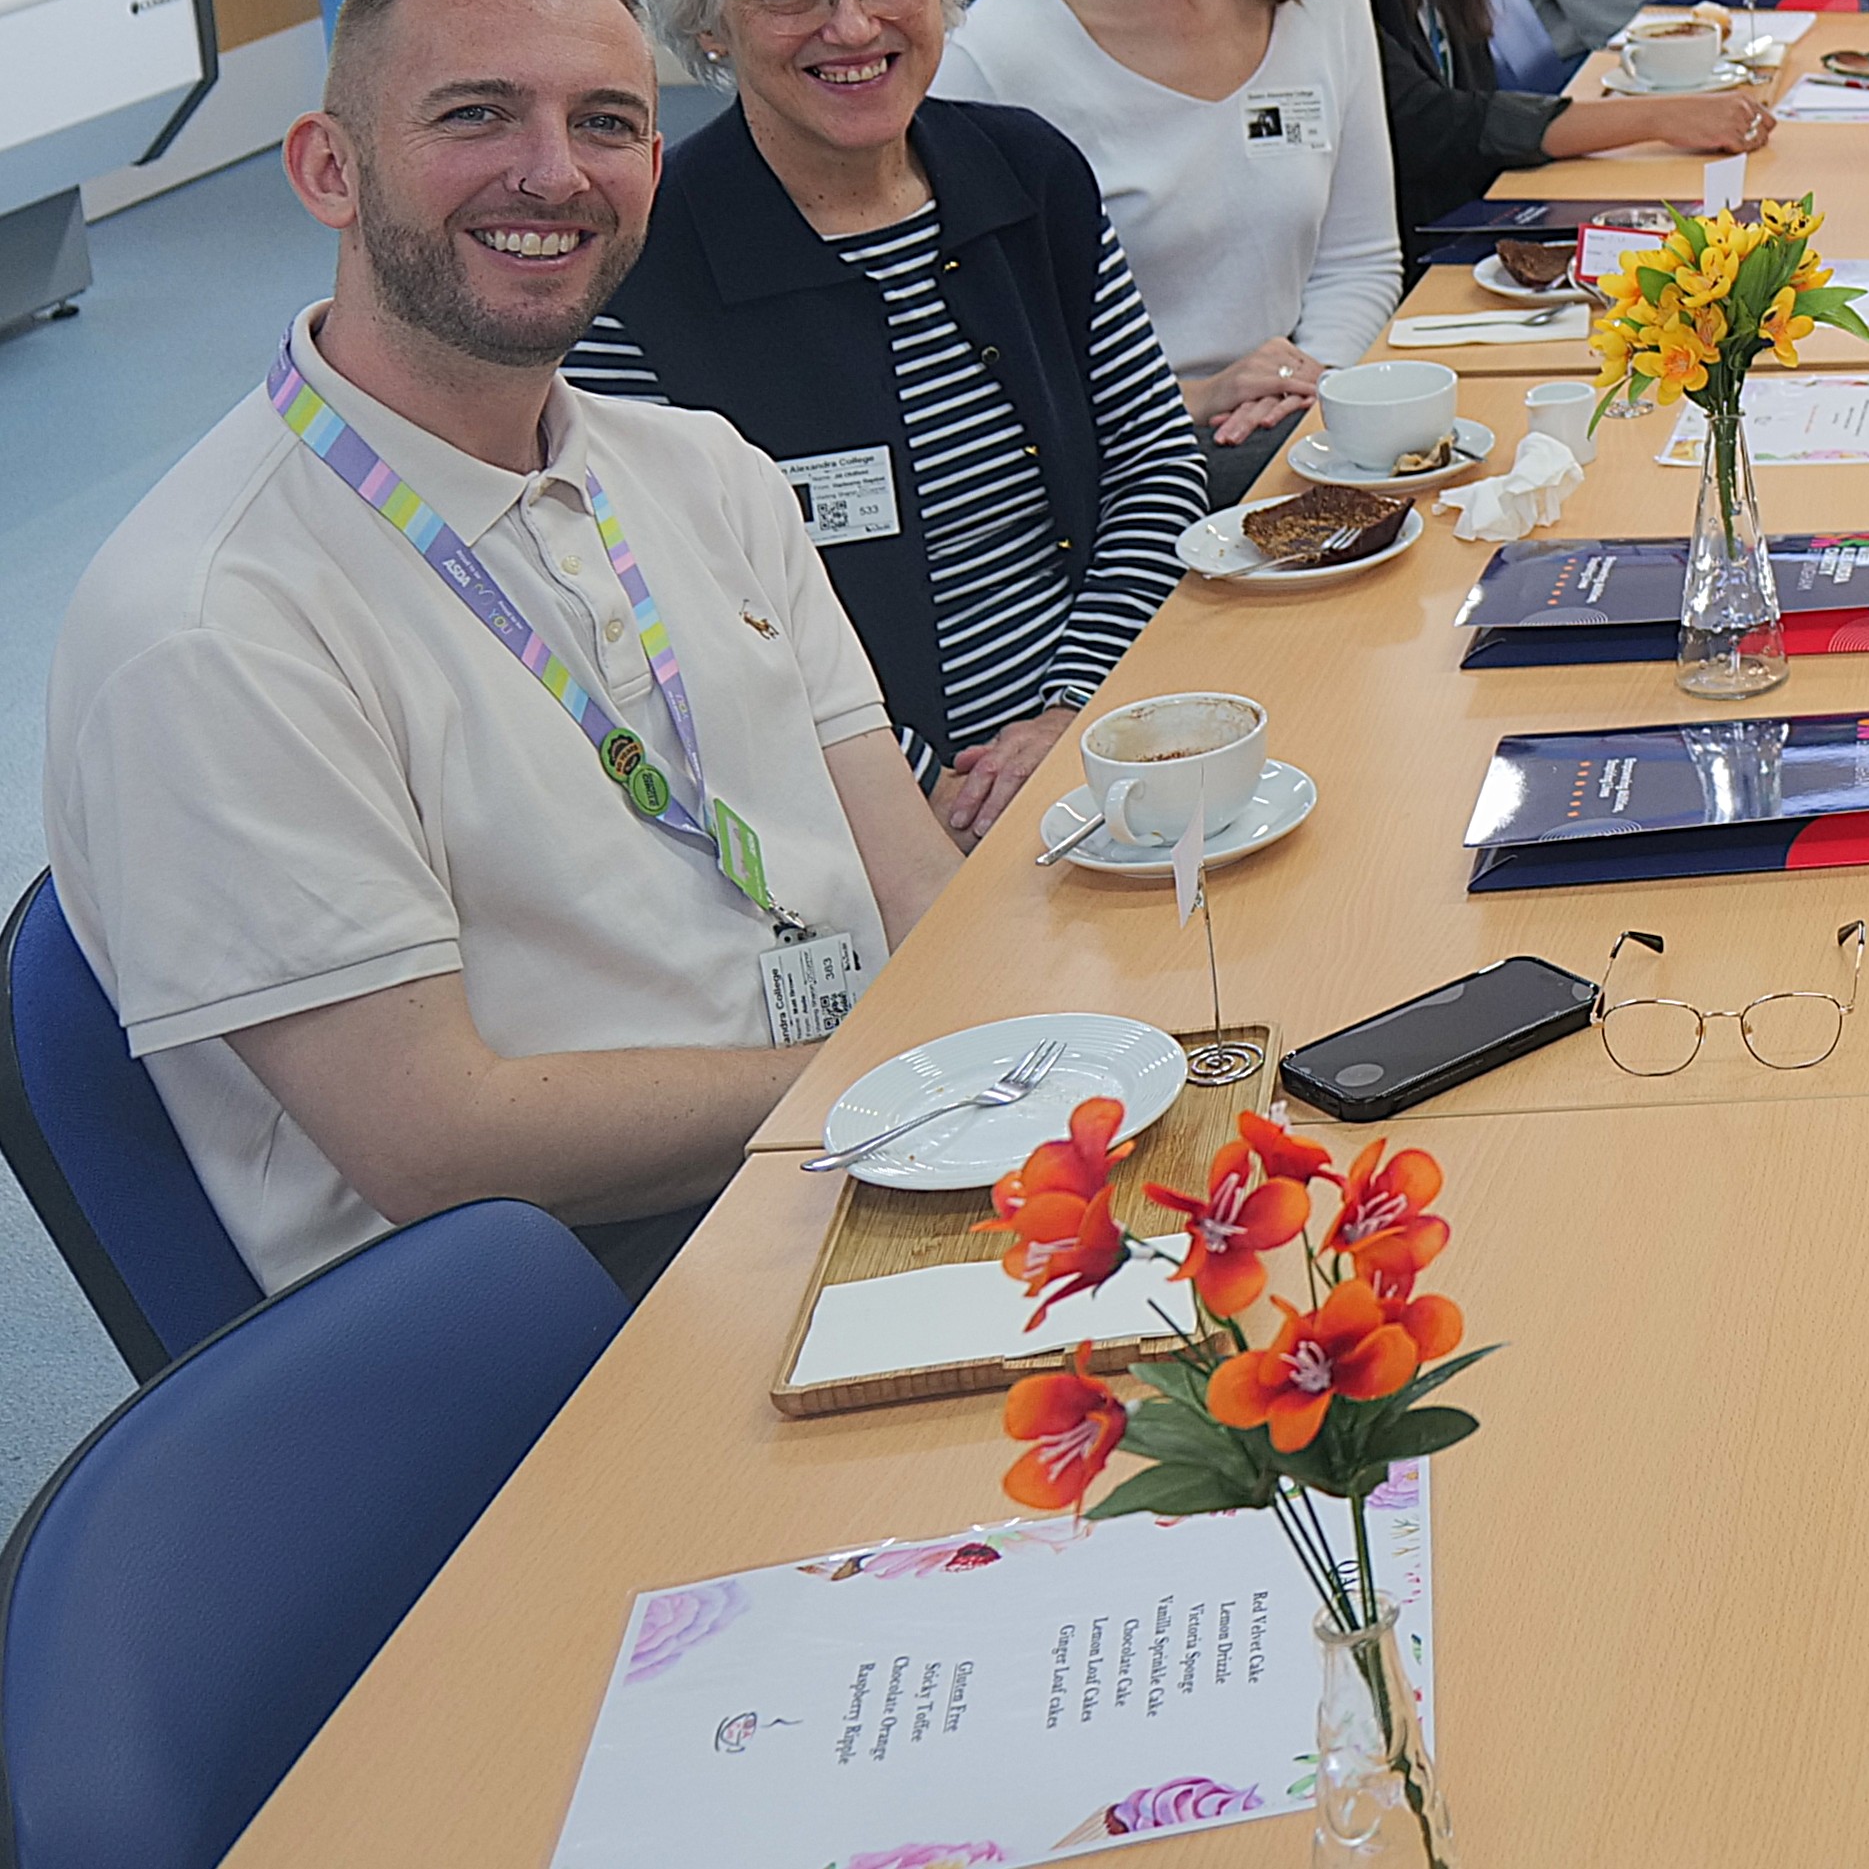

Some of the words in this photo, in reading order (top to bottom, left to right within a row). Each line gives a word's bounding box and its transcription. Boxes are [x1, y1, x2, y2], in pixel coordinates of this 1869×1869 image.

[790, 460, 837, 473] Alexandra
[839, 455, 874, 466] College
[859, 505, 879, 516] 533
[442, 559, 471, 588] ASDA
[1818, 547, 1840, 576] CHARITY
[1833, 547, 1857, 584] ALEXANDRA
[488, 608, 514, 635] YOU
[772, 968, 786, 1010] College
[779, 1011, 791, 1046] andra
[1154, 1595, 1174, 1635] Vanilla
[1218, 1601, 1236, 1640] Lemon
[1252, 1591, 1268, 1613] Red
[1051, 1624, 1076, 1665] Ginger
[1088, 1617, 1109, 1657] Lemon
[1186, 1603, 1205, 1649] Victoria
[1249, 1615, 1266, 1652] Velvet
[1118, 1619, 1139, 1676] Chocolate
[1148, 1636, 1169, 1685] Sprinkle
[1215, 1642, 1233, 1684] Drizzle
[883, 1655, 910, 1714] Chocolate
[915, 1661, 941, 1699] Sticky
[950, 1661, 974, 1702] Gluten
[1050, 1666, 1070, 1694] Loaf
[1085, 1657, 1103, 1685] Loaf
[1177, 1650, 1200, 1694] Sponge
[1248, 1654, 1265, 1683] Cake
[843, 1662, 876, 1721] Raspberry
[1080, 1687, 1100, 1723] Cakes
[1115, 1677, 1133, 1707] Cake
[1146, 1687, 1165, 1718] Cake
[911, 1701, 934, 1742] Toffee
[944, 1704, 967, 1732] Free
[1047, 1696, 1065, 1730] cakes
[835, 1724, 862, 1765] Ripple
[870, 1716, 898, 1762] Orange
